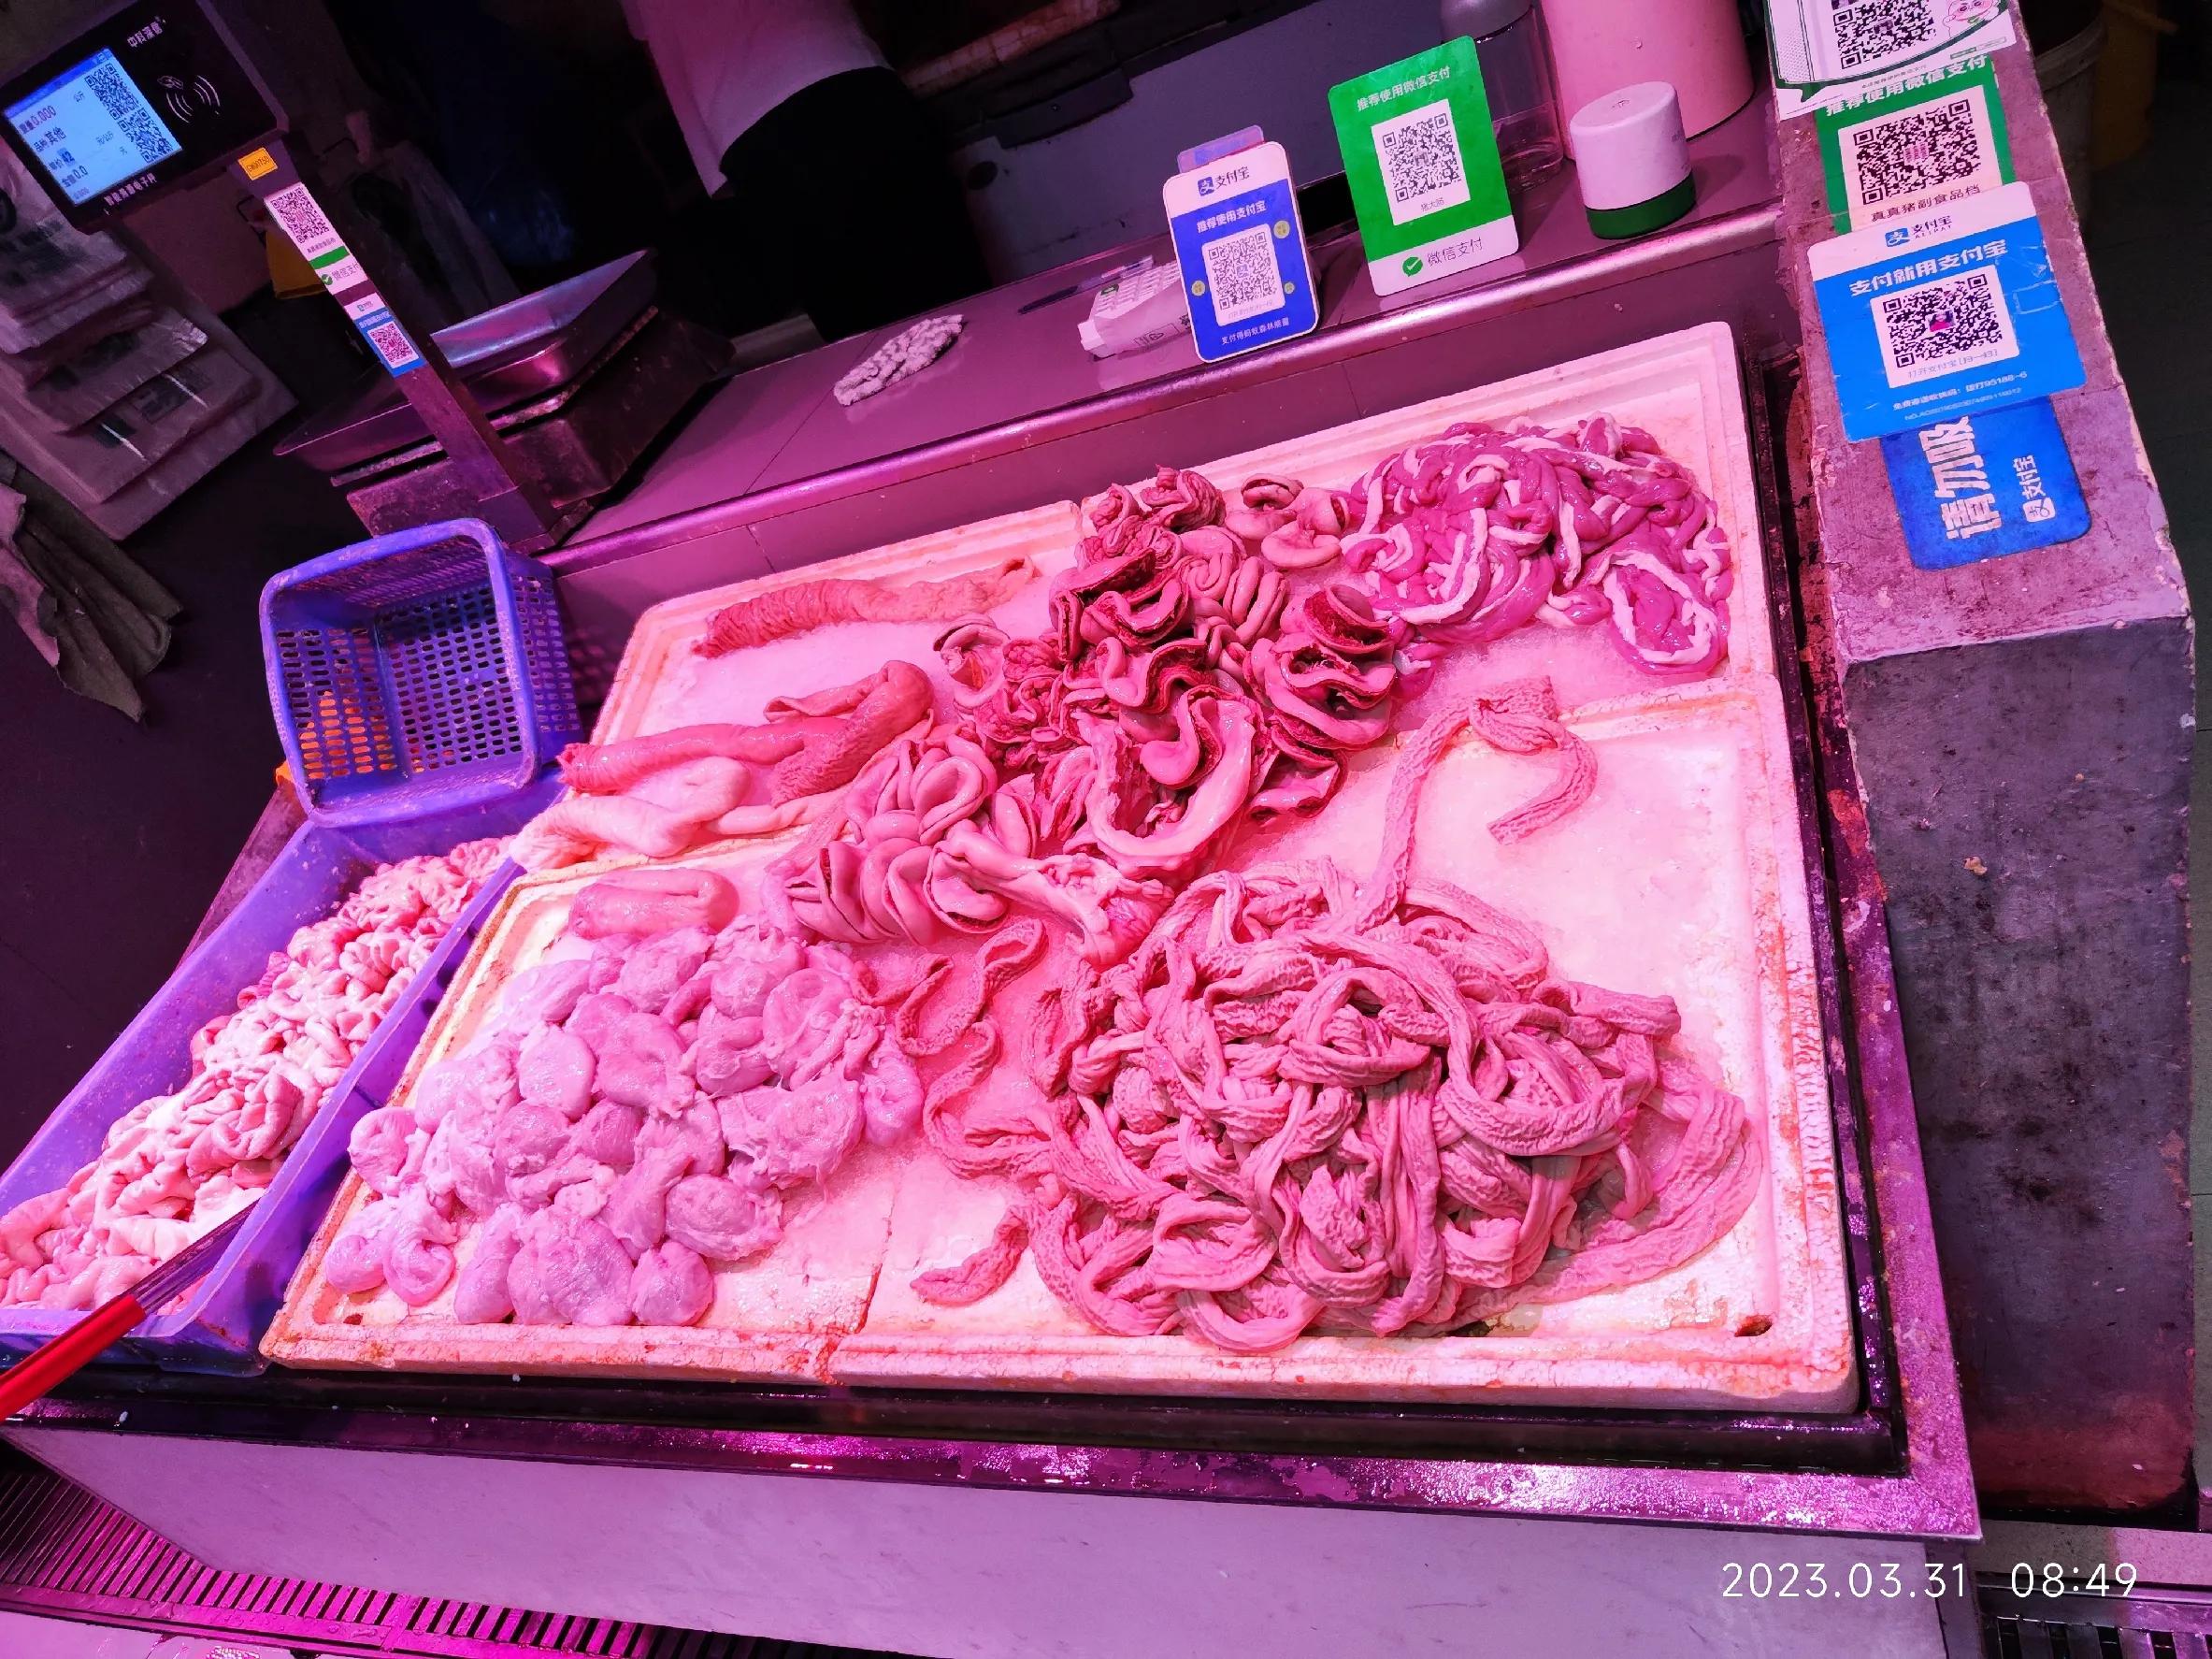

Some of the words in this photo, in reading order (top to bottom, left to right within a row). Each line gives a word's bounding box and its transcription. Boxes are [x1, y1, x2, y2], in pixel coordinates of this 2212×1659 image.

[1356, 65, 1451, 112] 推荐使用微信支付
[1825, 53, 1989, 117] 推荐使用微信支付
[1214, 166, 1250, 190] 支付宝
[1197, 200, 1268, 234] 推荐使用支付宝
[1871, 183, 1981, 223] 真真猪副食品档
[1912, 215, 1952, 234] 支付宝
[1427, 236, 1484, 267] 微信支付
[1848, 238, 2008, 297] 支付就用支付宝
[1918, 416, 2002, 540] 请勿吸
[2013, 454, 2047, 499] 支付宝
